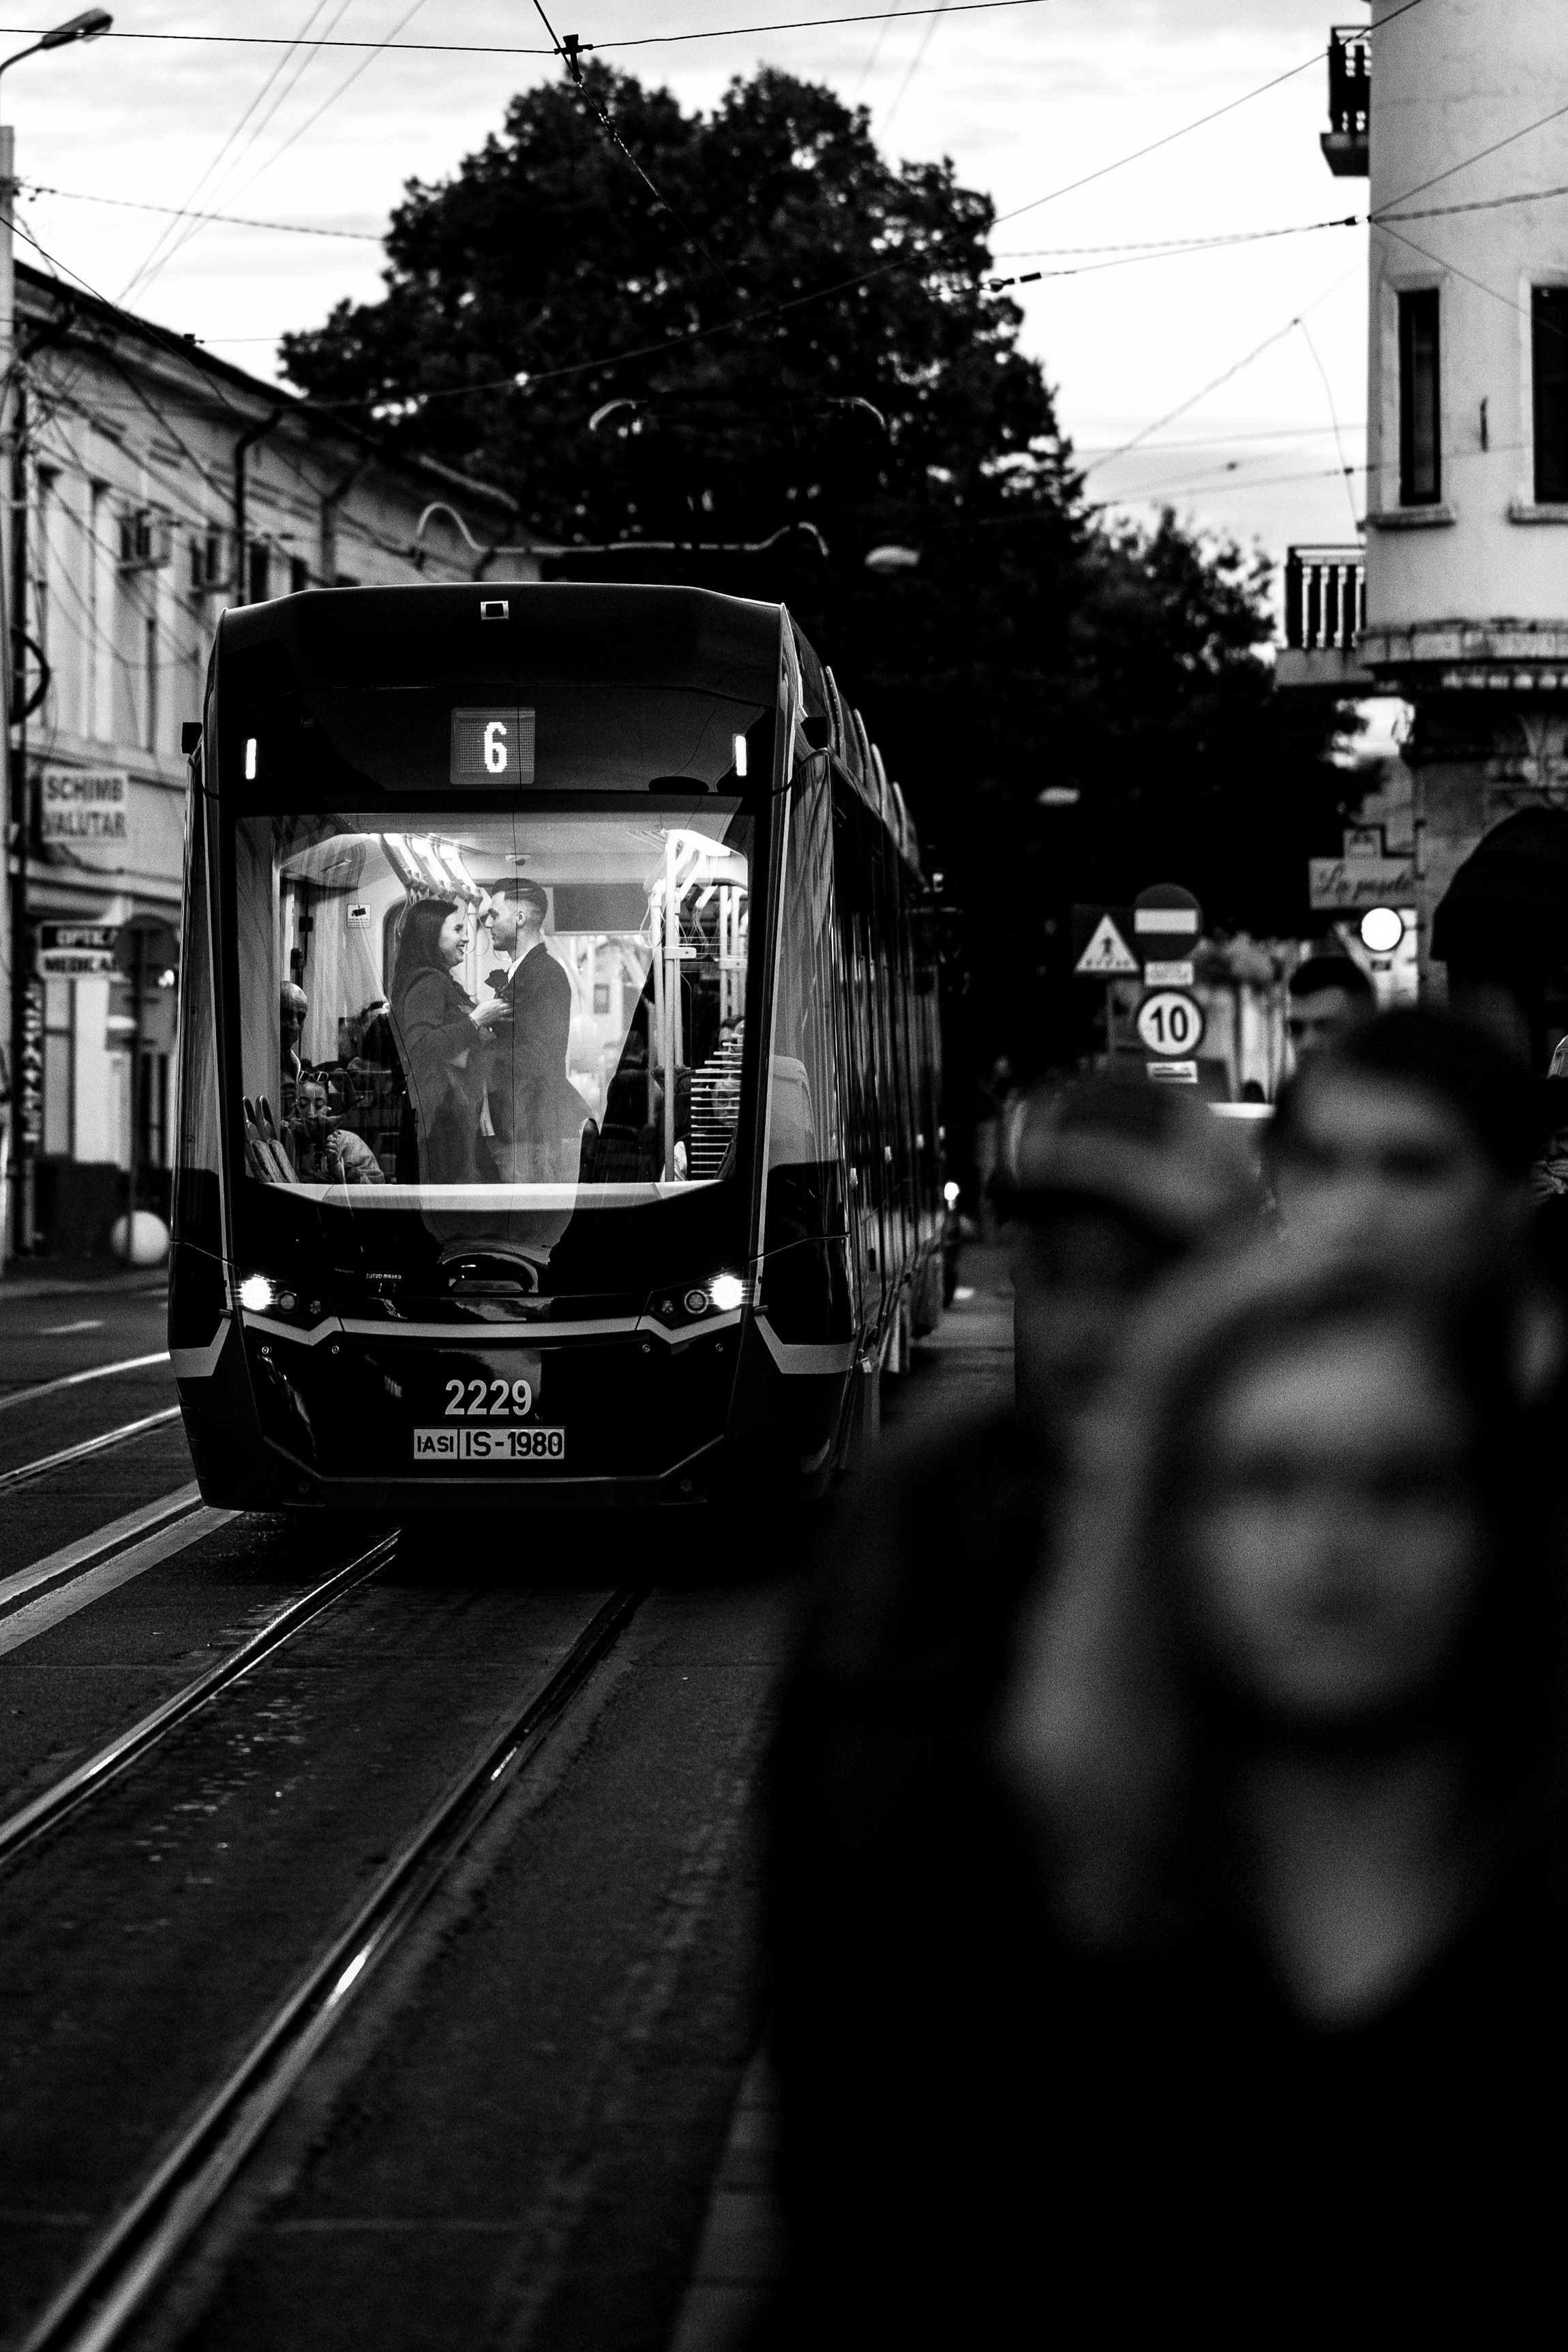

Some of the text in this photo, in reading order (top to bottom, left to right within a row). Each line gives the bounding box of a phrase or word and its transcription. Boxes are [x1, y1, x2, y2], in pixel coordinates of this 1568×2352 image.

[483, 721, 507, 773] 6
[48, 775, 123, 802] SCHIMB
[1149, 1005, 1188, 1043] 10
[444, 1379, 532, 1416] 2229
[417, 1431, 562, 1457] IASI IS-1980
